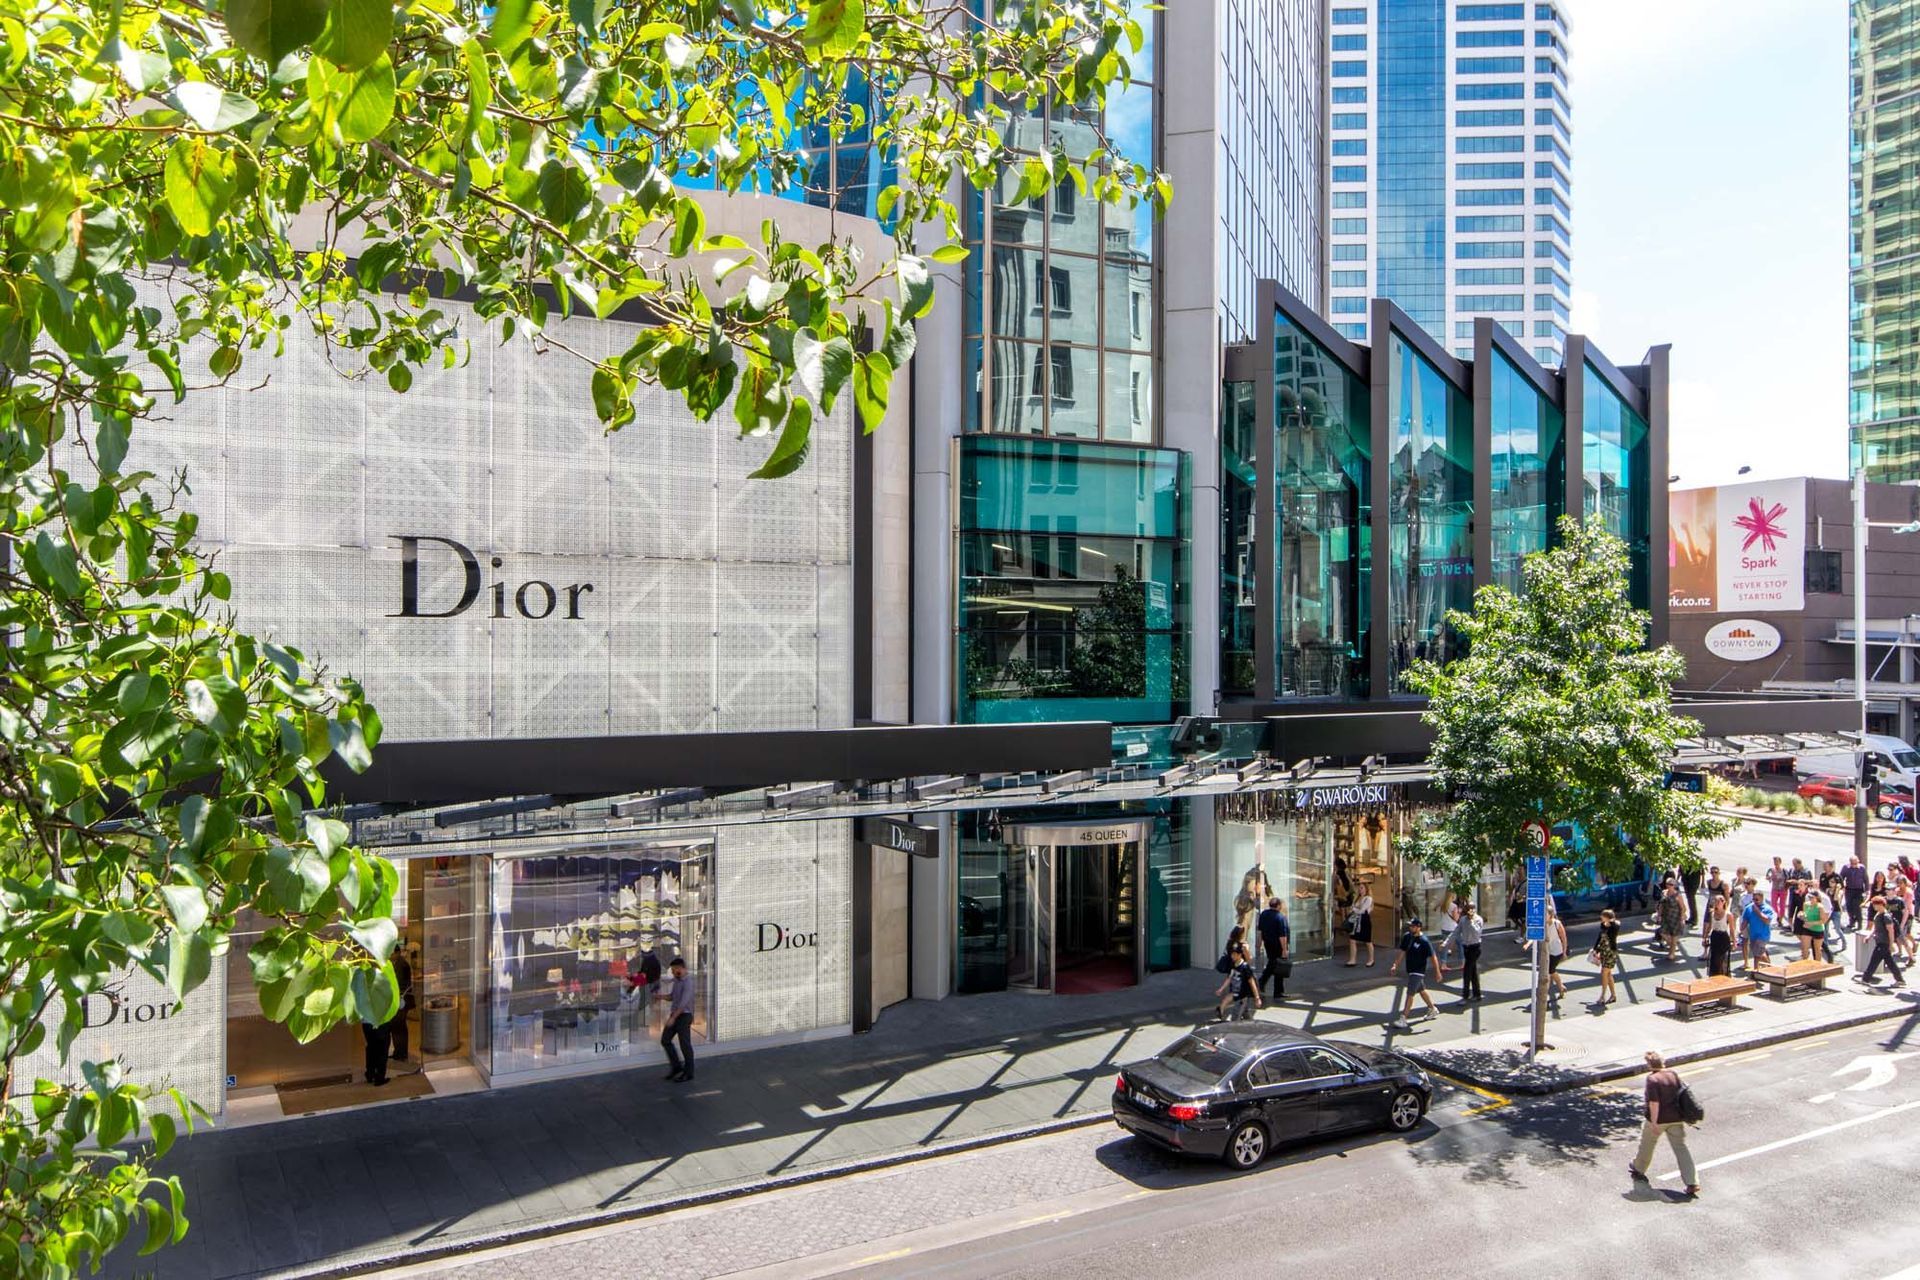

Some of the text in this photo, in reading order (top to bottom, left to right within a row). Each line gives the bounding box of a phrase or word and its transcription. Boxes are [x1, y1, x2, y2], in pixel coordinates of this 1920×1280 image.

[1741, 557, 1777, 571] Spark
[385, 535, 593, 619] Dior
[1733, 580, 1788, 590] NEVER STOP
[1669, 596, 1711, 607] rk.co.nz
[1739, 593, 1782, 601] STARTING
[1713, 639, 1772, 648] DOWNTOWN
[1313, 785, 1387, 806] SWAROVSKI
[891, 825, 916, 852] Dior
[1080, 829, 1128, 841] 45 QUEEN
[753, 922, 818, 953] Dior
[81, 991, 175, 1029] Dior
[593, 1042, 620, 1054] Dior
